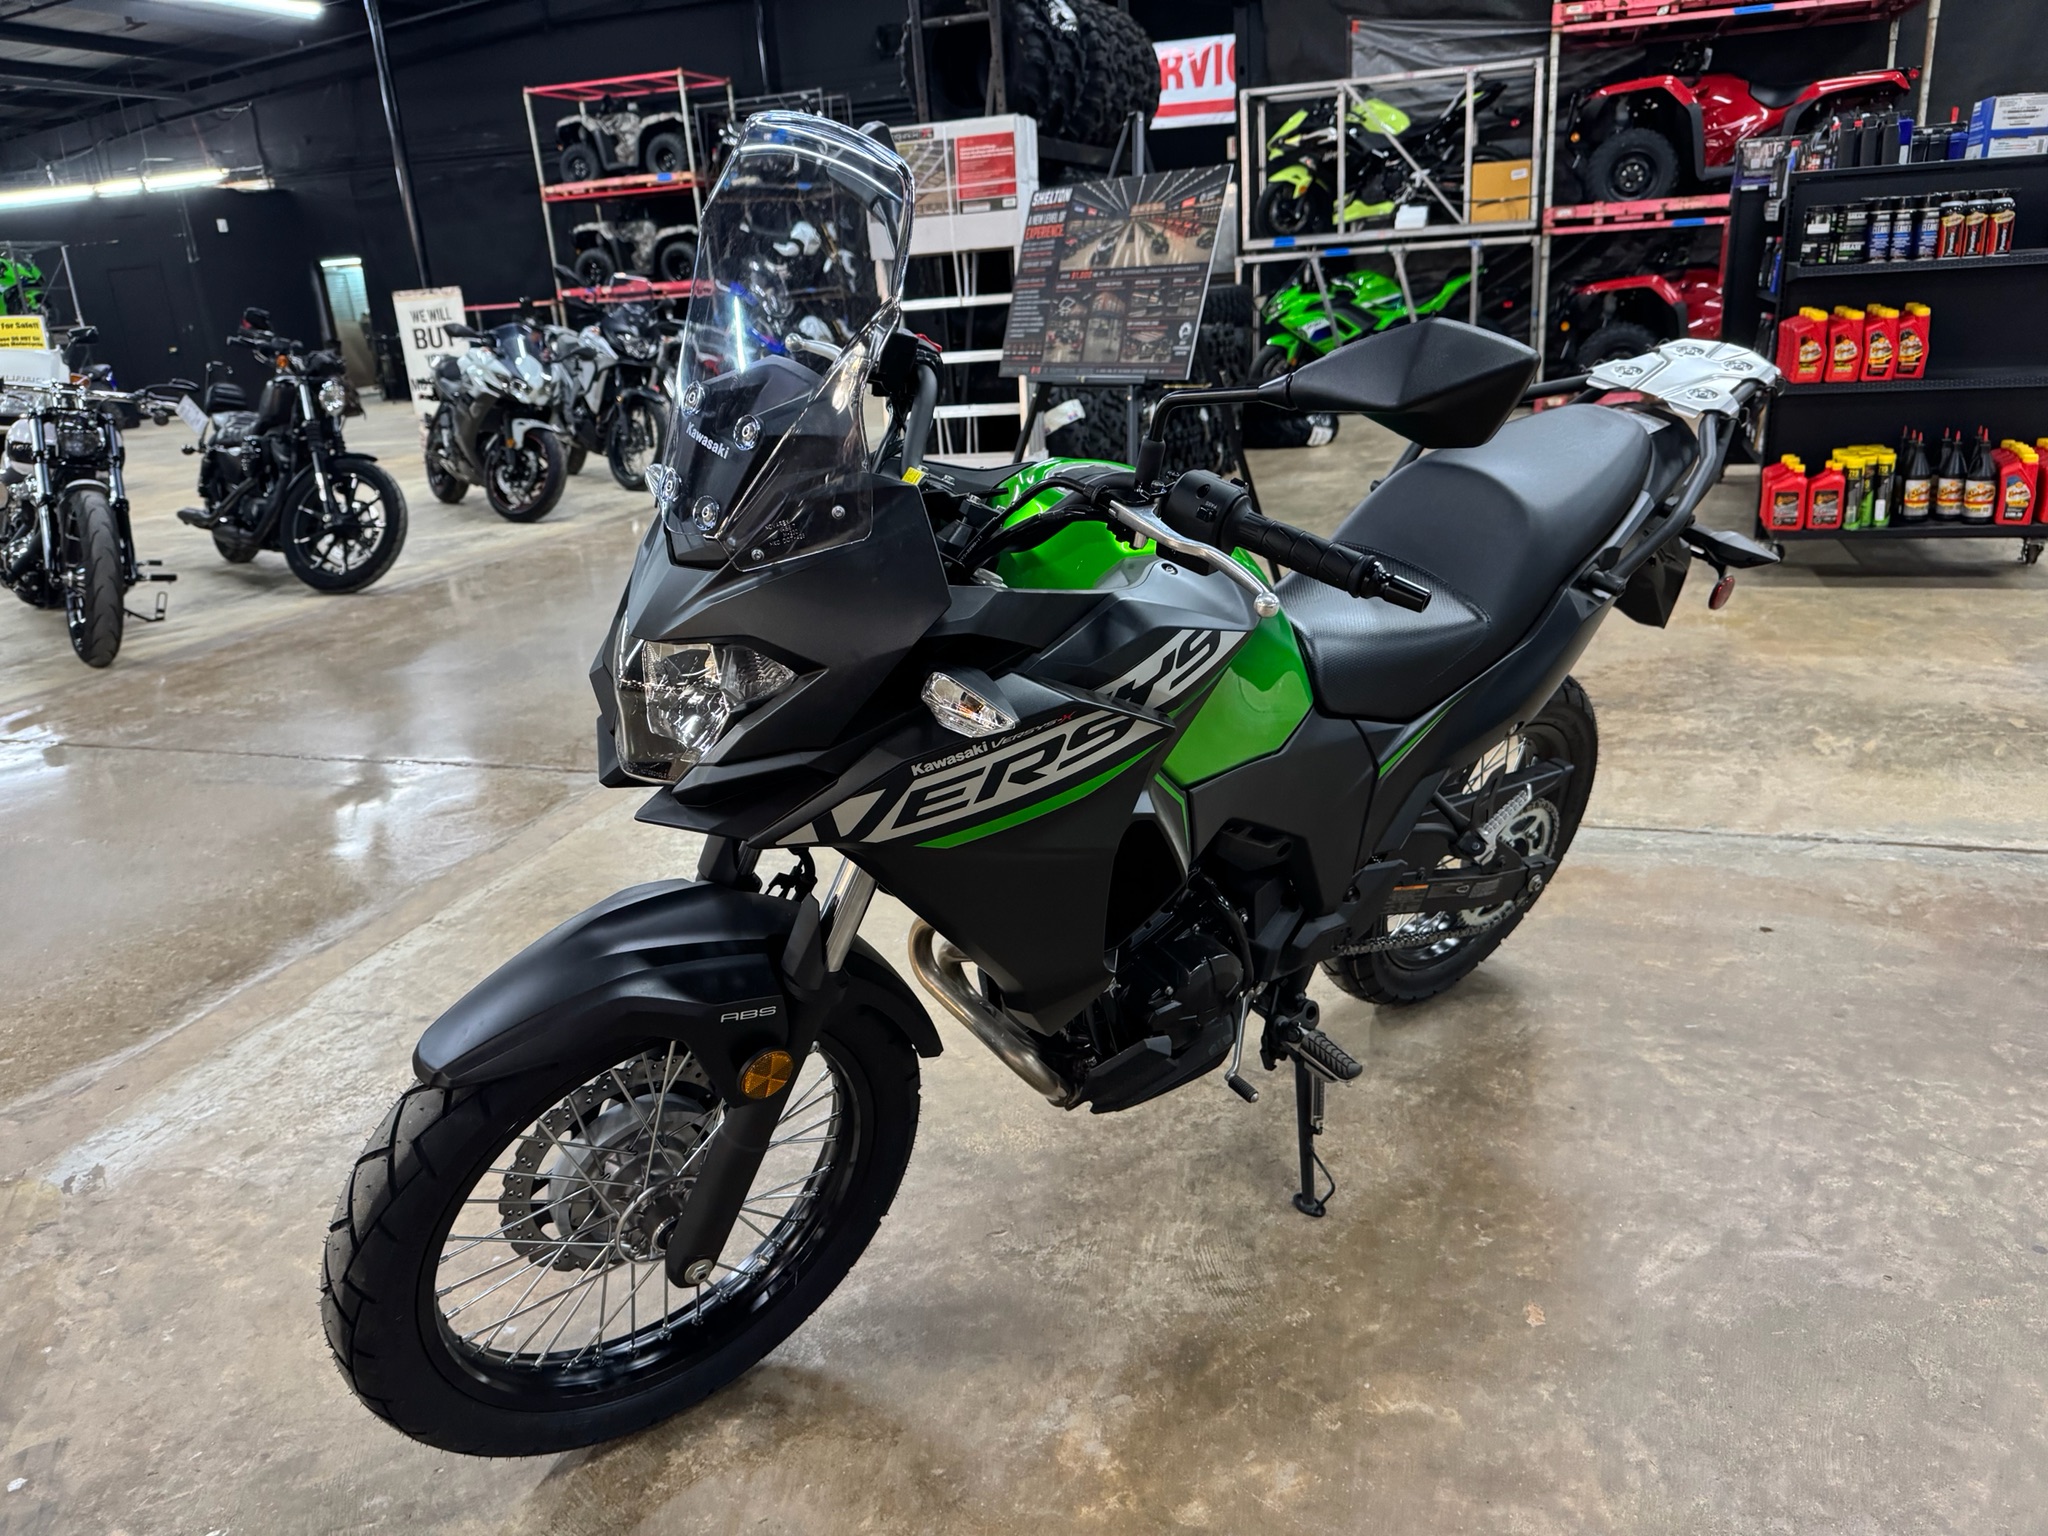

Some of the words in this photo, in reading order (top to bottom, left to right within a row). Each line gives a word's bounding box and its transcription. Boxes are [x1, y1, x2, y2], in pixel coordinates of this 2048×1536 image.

[1031, 187, 1074, 206] SHELTON
[410, 309, 427, 323] WE
[427, 307, 452, 322] WILL
[685, 422, 730, 460] Kawasaki
[911, 741, 988, 777] Kawasaki
[992, 711, 1077, 749] VERSYS-X
[720, 1005, 777, 1023] ABS
